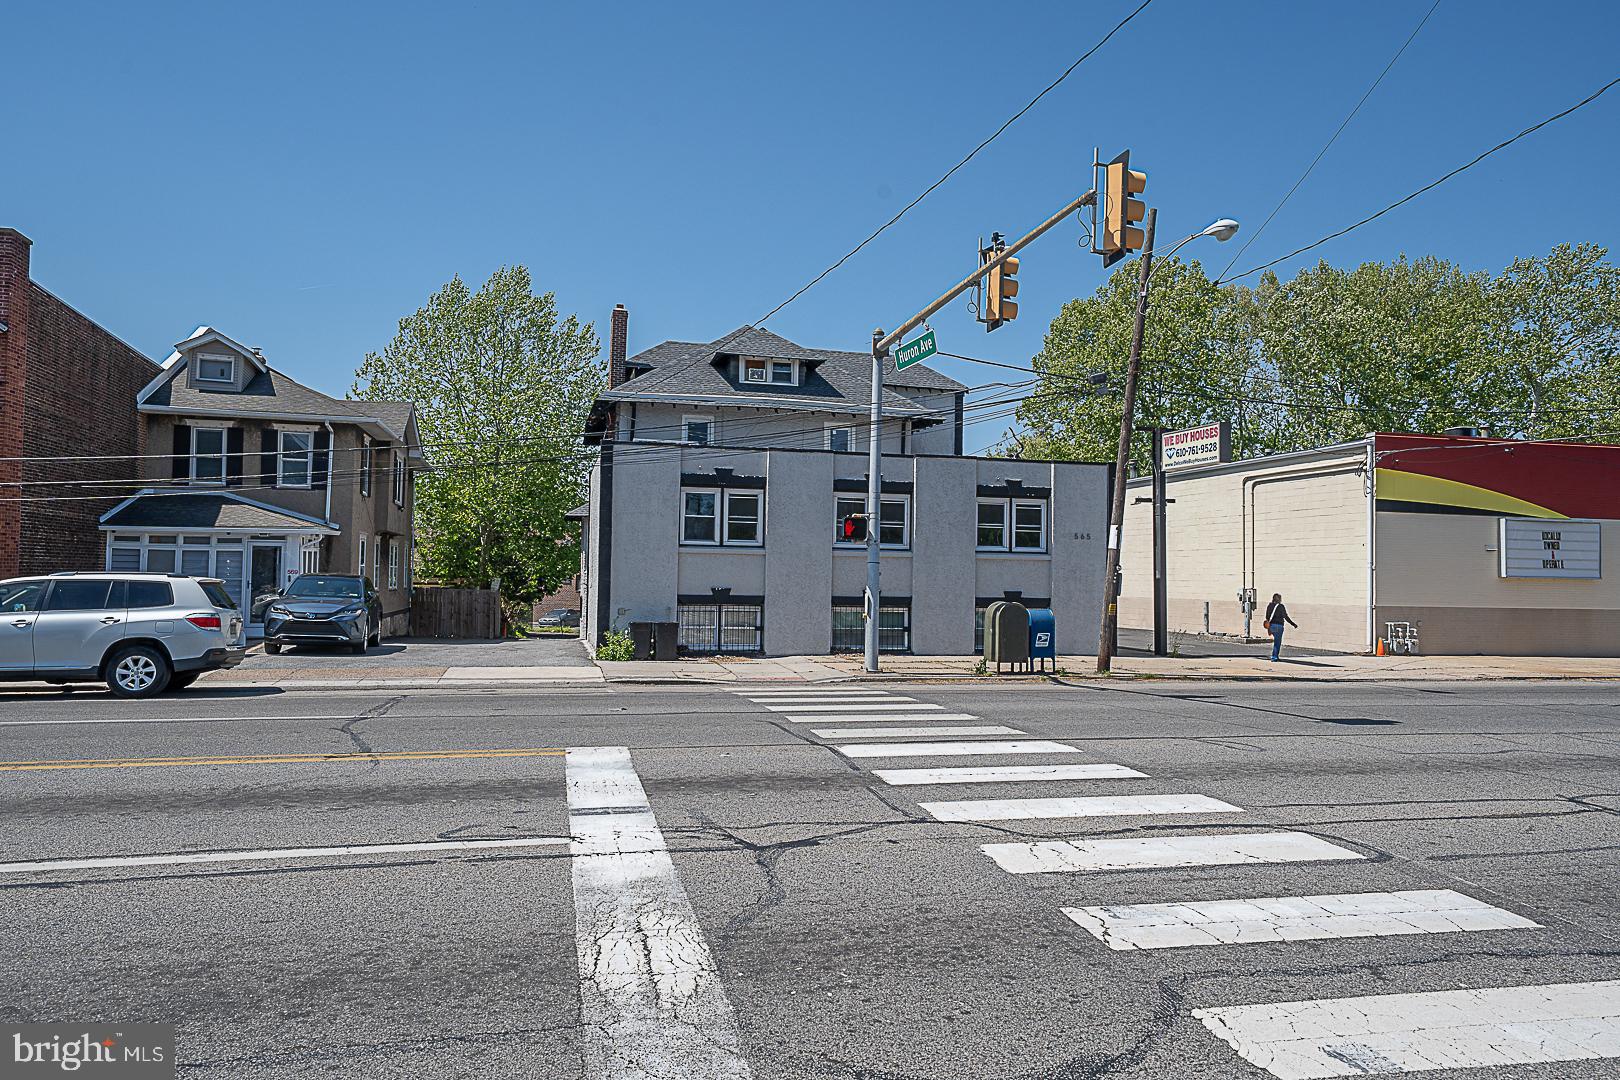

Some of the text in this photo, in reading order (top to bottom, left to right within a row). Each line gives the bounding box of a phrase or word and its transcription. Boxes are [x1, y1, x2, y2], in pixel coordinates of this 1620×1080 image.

[898, 338, 933, 364] Huron Ave
[1164, 426, 1219, 447] WE BUY HOUSES
[1074, 532, 1092, 540] 565
